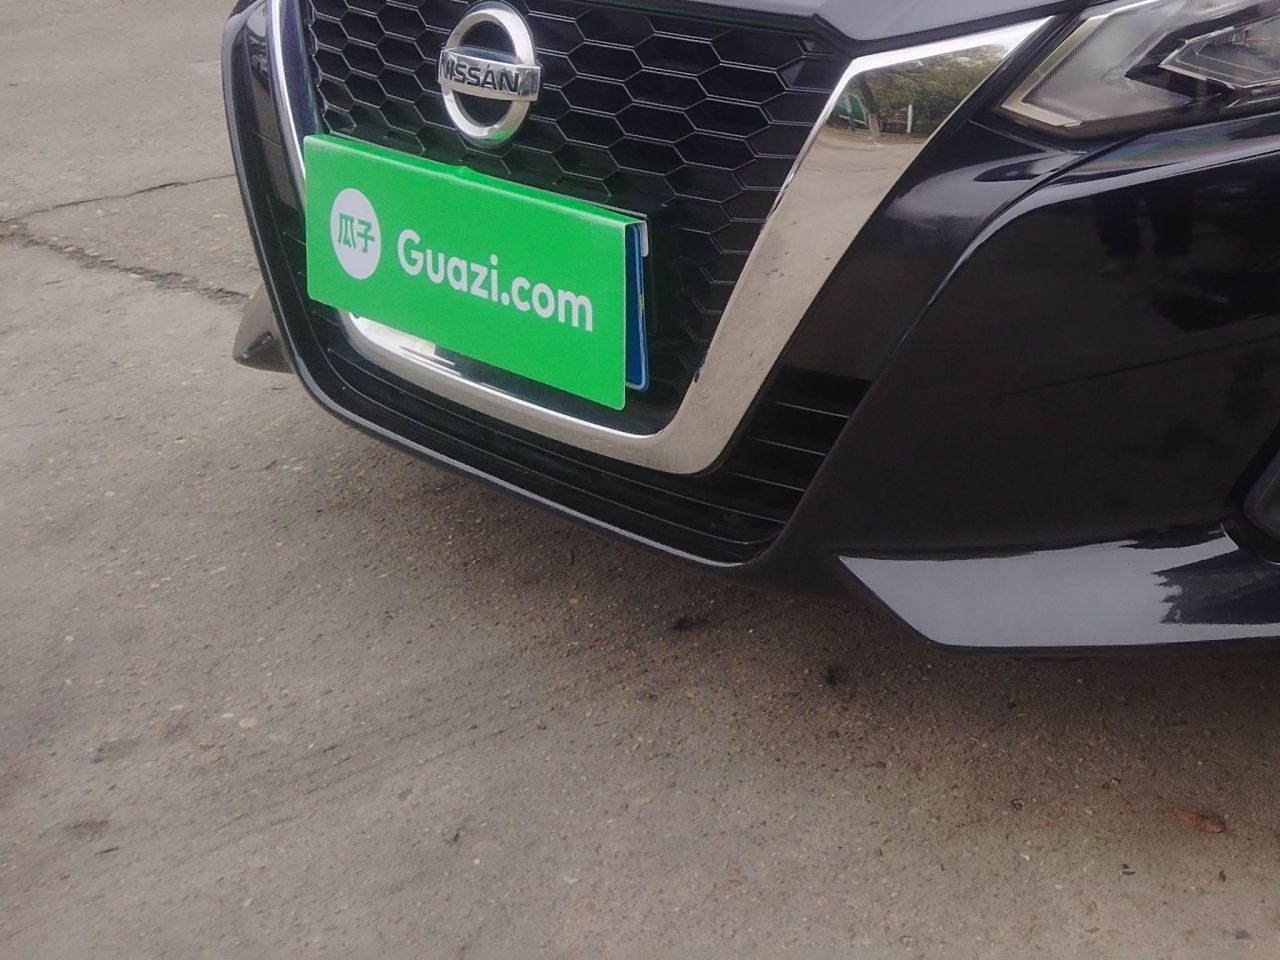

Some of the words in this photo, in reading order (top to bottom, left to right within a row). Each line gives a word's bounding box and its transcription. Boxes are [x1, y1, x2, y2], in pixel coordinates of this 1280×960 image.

[441, 55, 520, 95] NISSAN
[337, 212, 375, 253] 瓜子
[396, 228, 594, 332] Guazi.com
